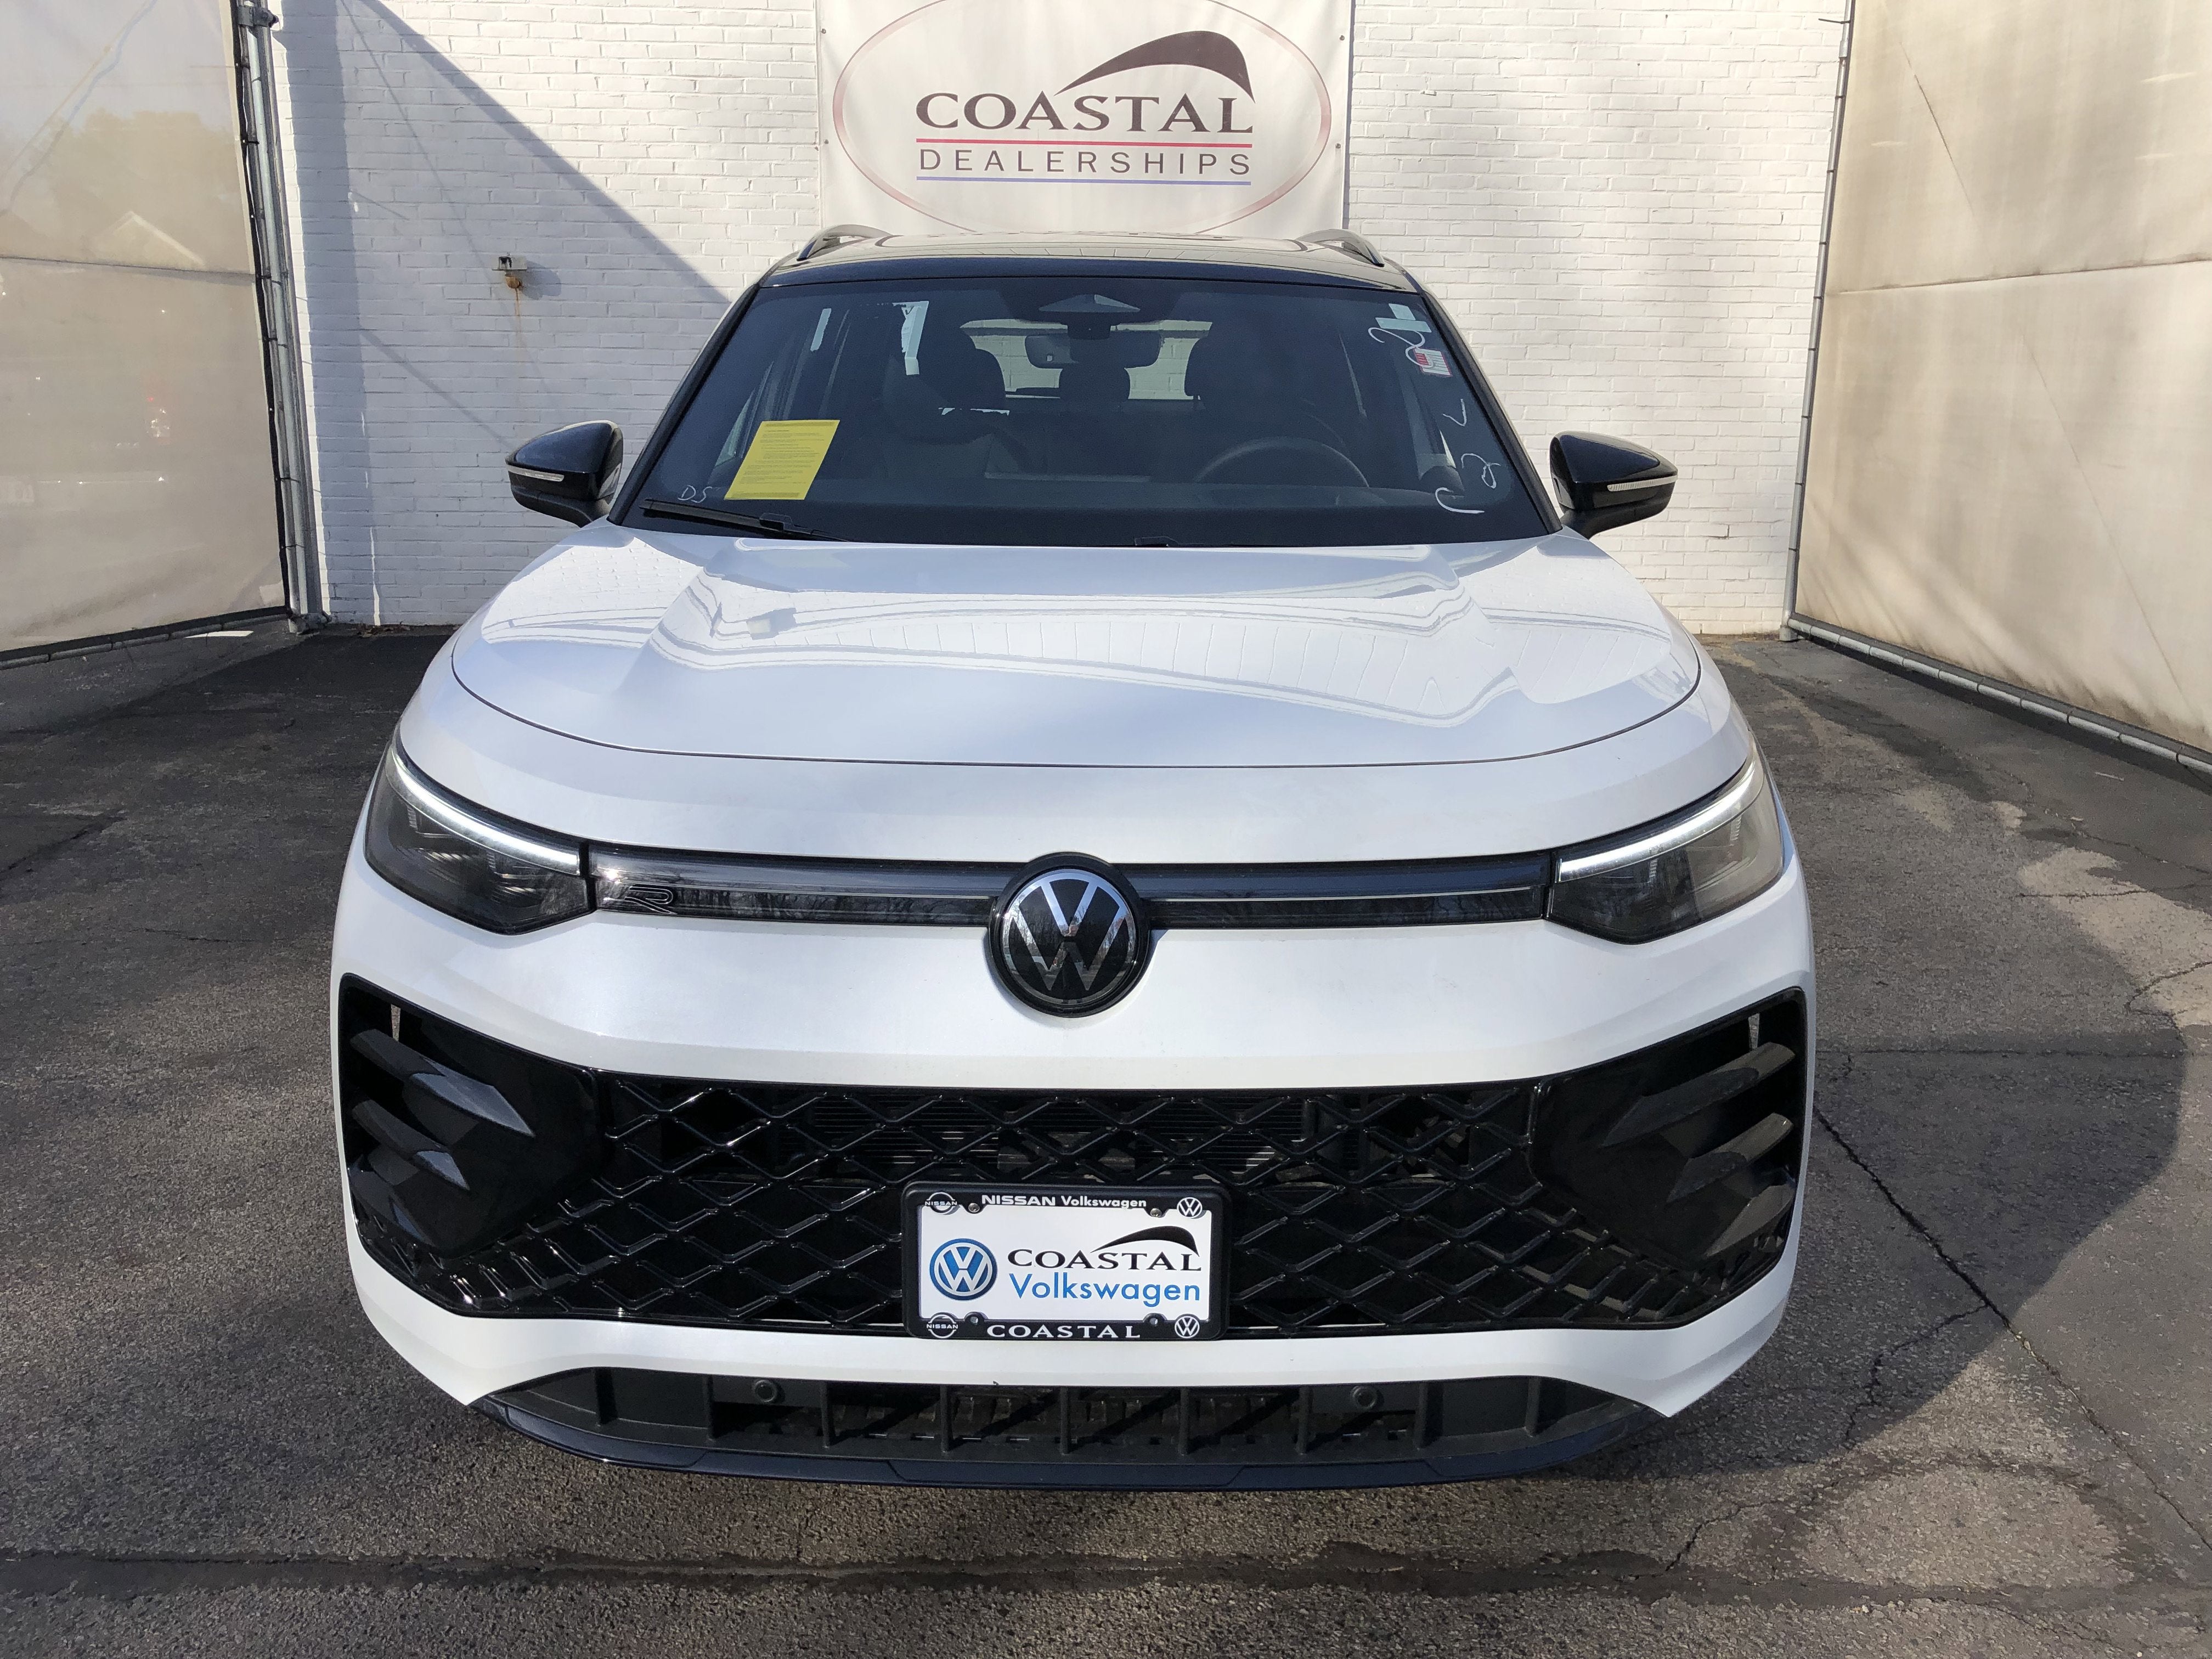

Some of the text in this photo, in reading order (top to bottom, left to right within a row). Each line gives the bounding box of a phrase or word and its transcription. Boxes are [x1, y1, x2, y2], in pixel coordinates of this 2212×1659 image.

[916, 90, 1254, 134] COASTAL
[919, 149, 1250, 175] DEALERSHIPS
[981, 1195, 1147, 1209] NISSAN Volkswagen
[1007, 1249, 1201, 1271] COASTAL
[1009, 1272, 1200, 1307] Volkswagen
[986, 1324, 1141, 1339] COASTAL
